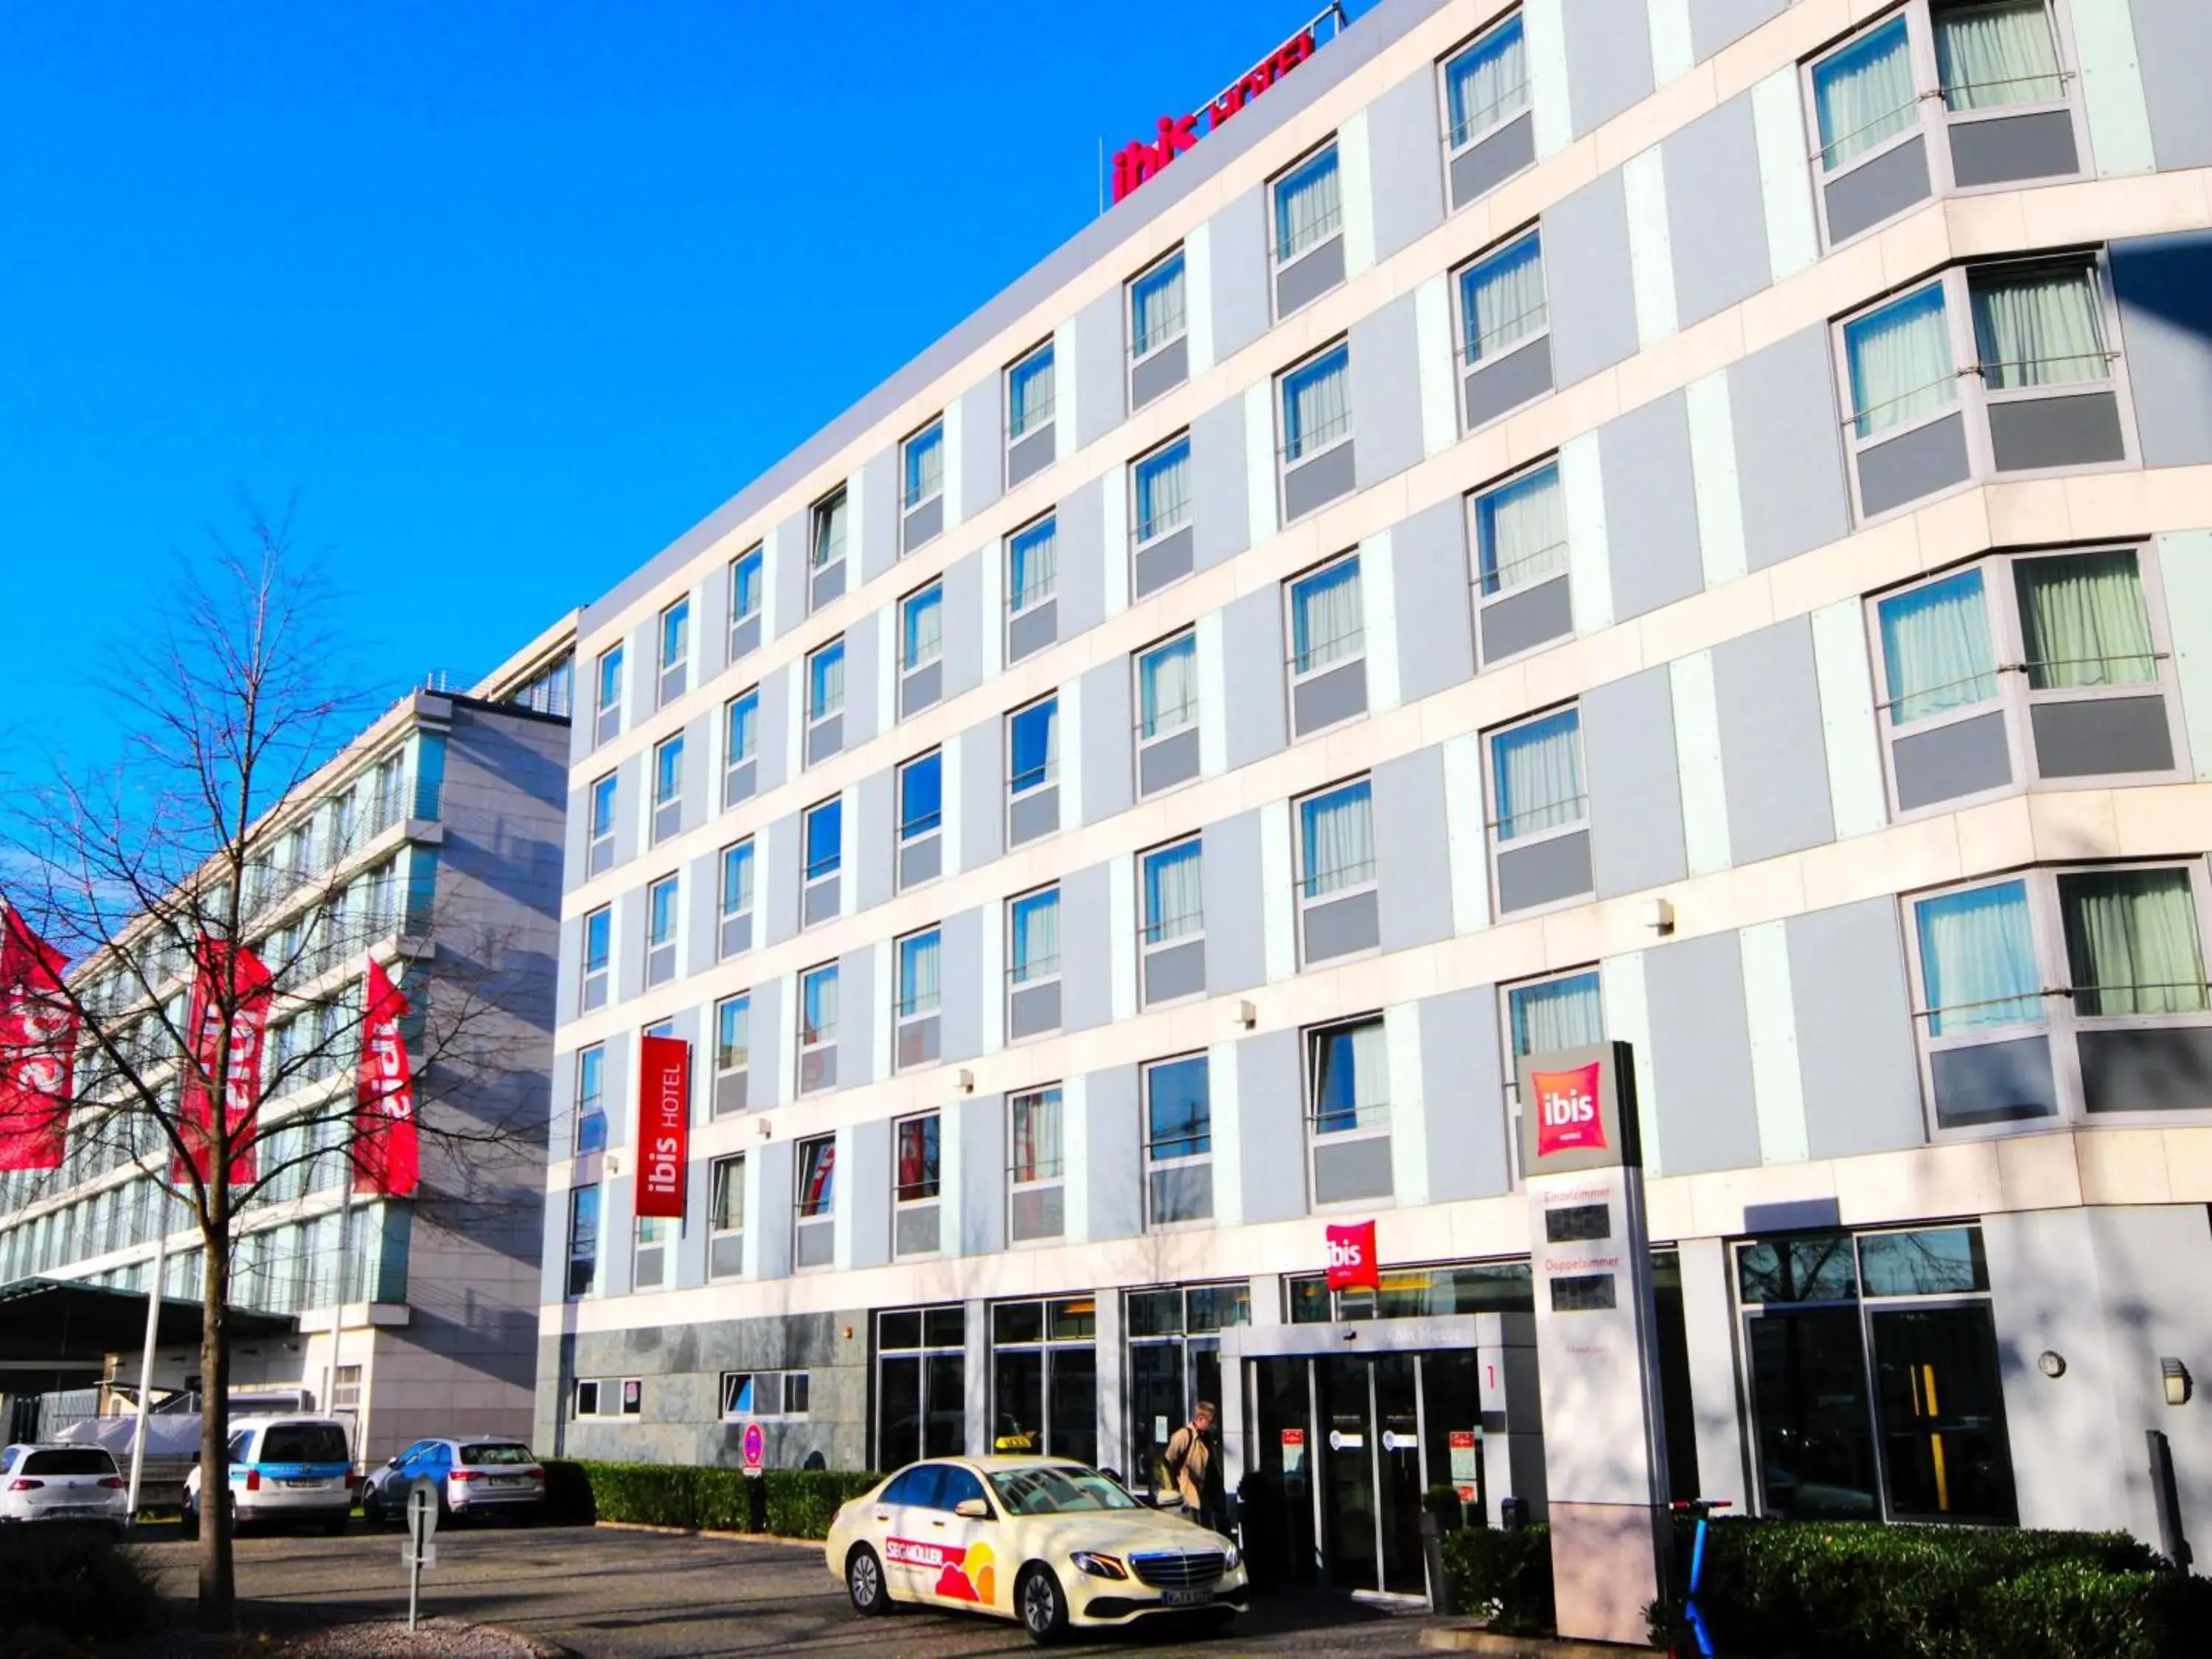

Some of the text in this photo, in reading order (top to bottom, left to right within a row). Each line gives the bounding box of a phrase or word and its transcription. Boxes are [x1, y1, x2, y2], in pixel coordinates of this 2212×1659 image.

[1544, 1088, 1594, 1126] ibis
[647, 1062, 680, 1192] ibis HOTEL
[1545, 1256, 1619, 1273] Doppelzimmer
[1487, 1366, 1495, 1390] 1
